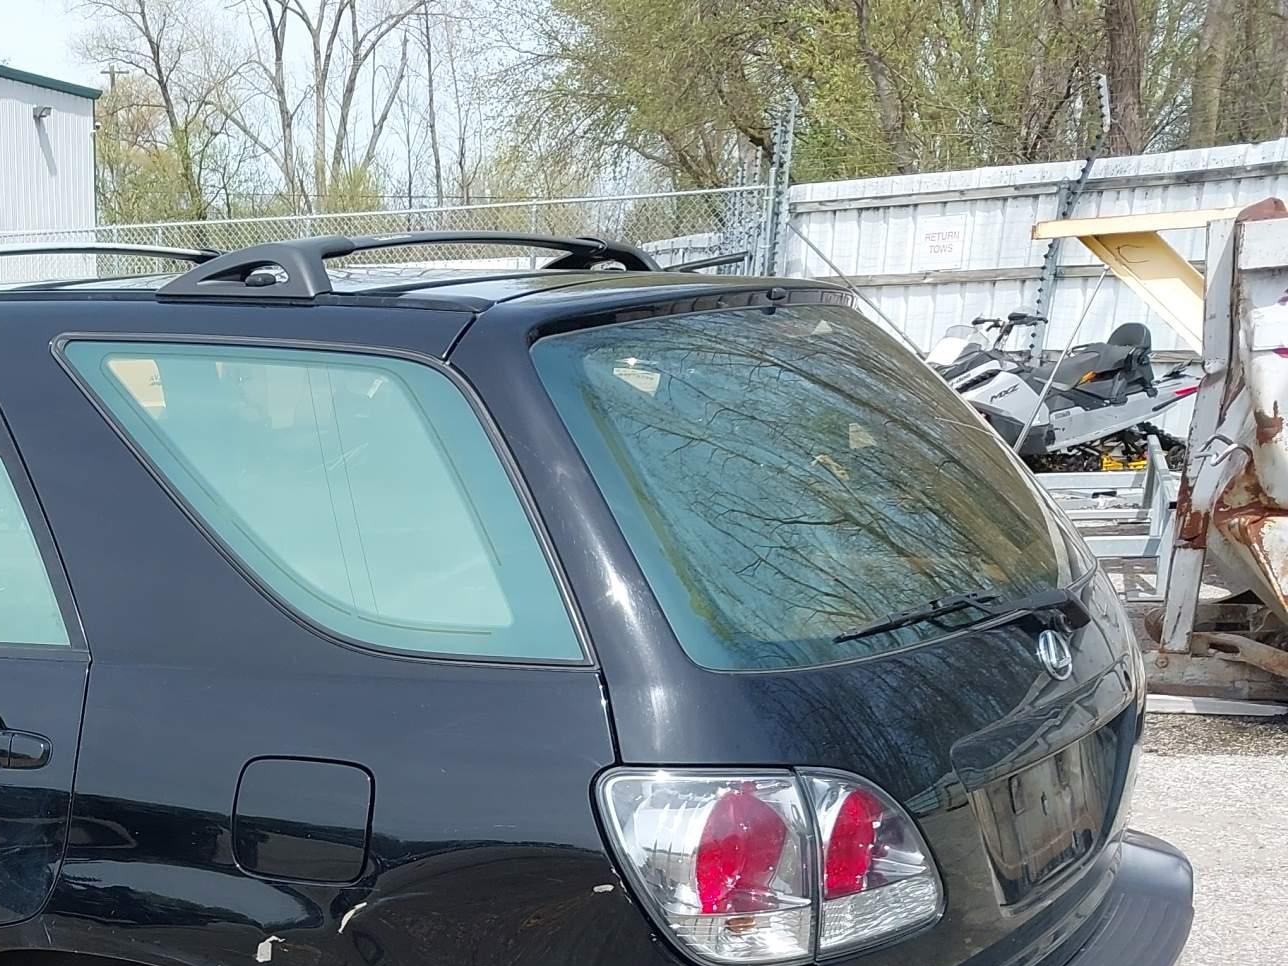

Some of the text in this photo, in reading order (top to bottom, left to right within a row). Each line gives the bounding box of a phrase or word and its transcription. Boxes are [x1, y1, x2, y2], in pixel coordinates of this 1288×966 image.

[925, 231, 960, 241] RETURN
[929, 244, 953, 254] TOWS
[990, 383, 1020, 402] MXZ
